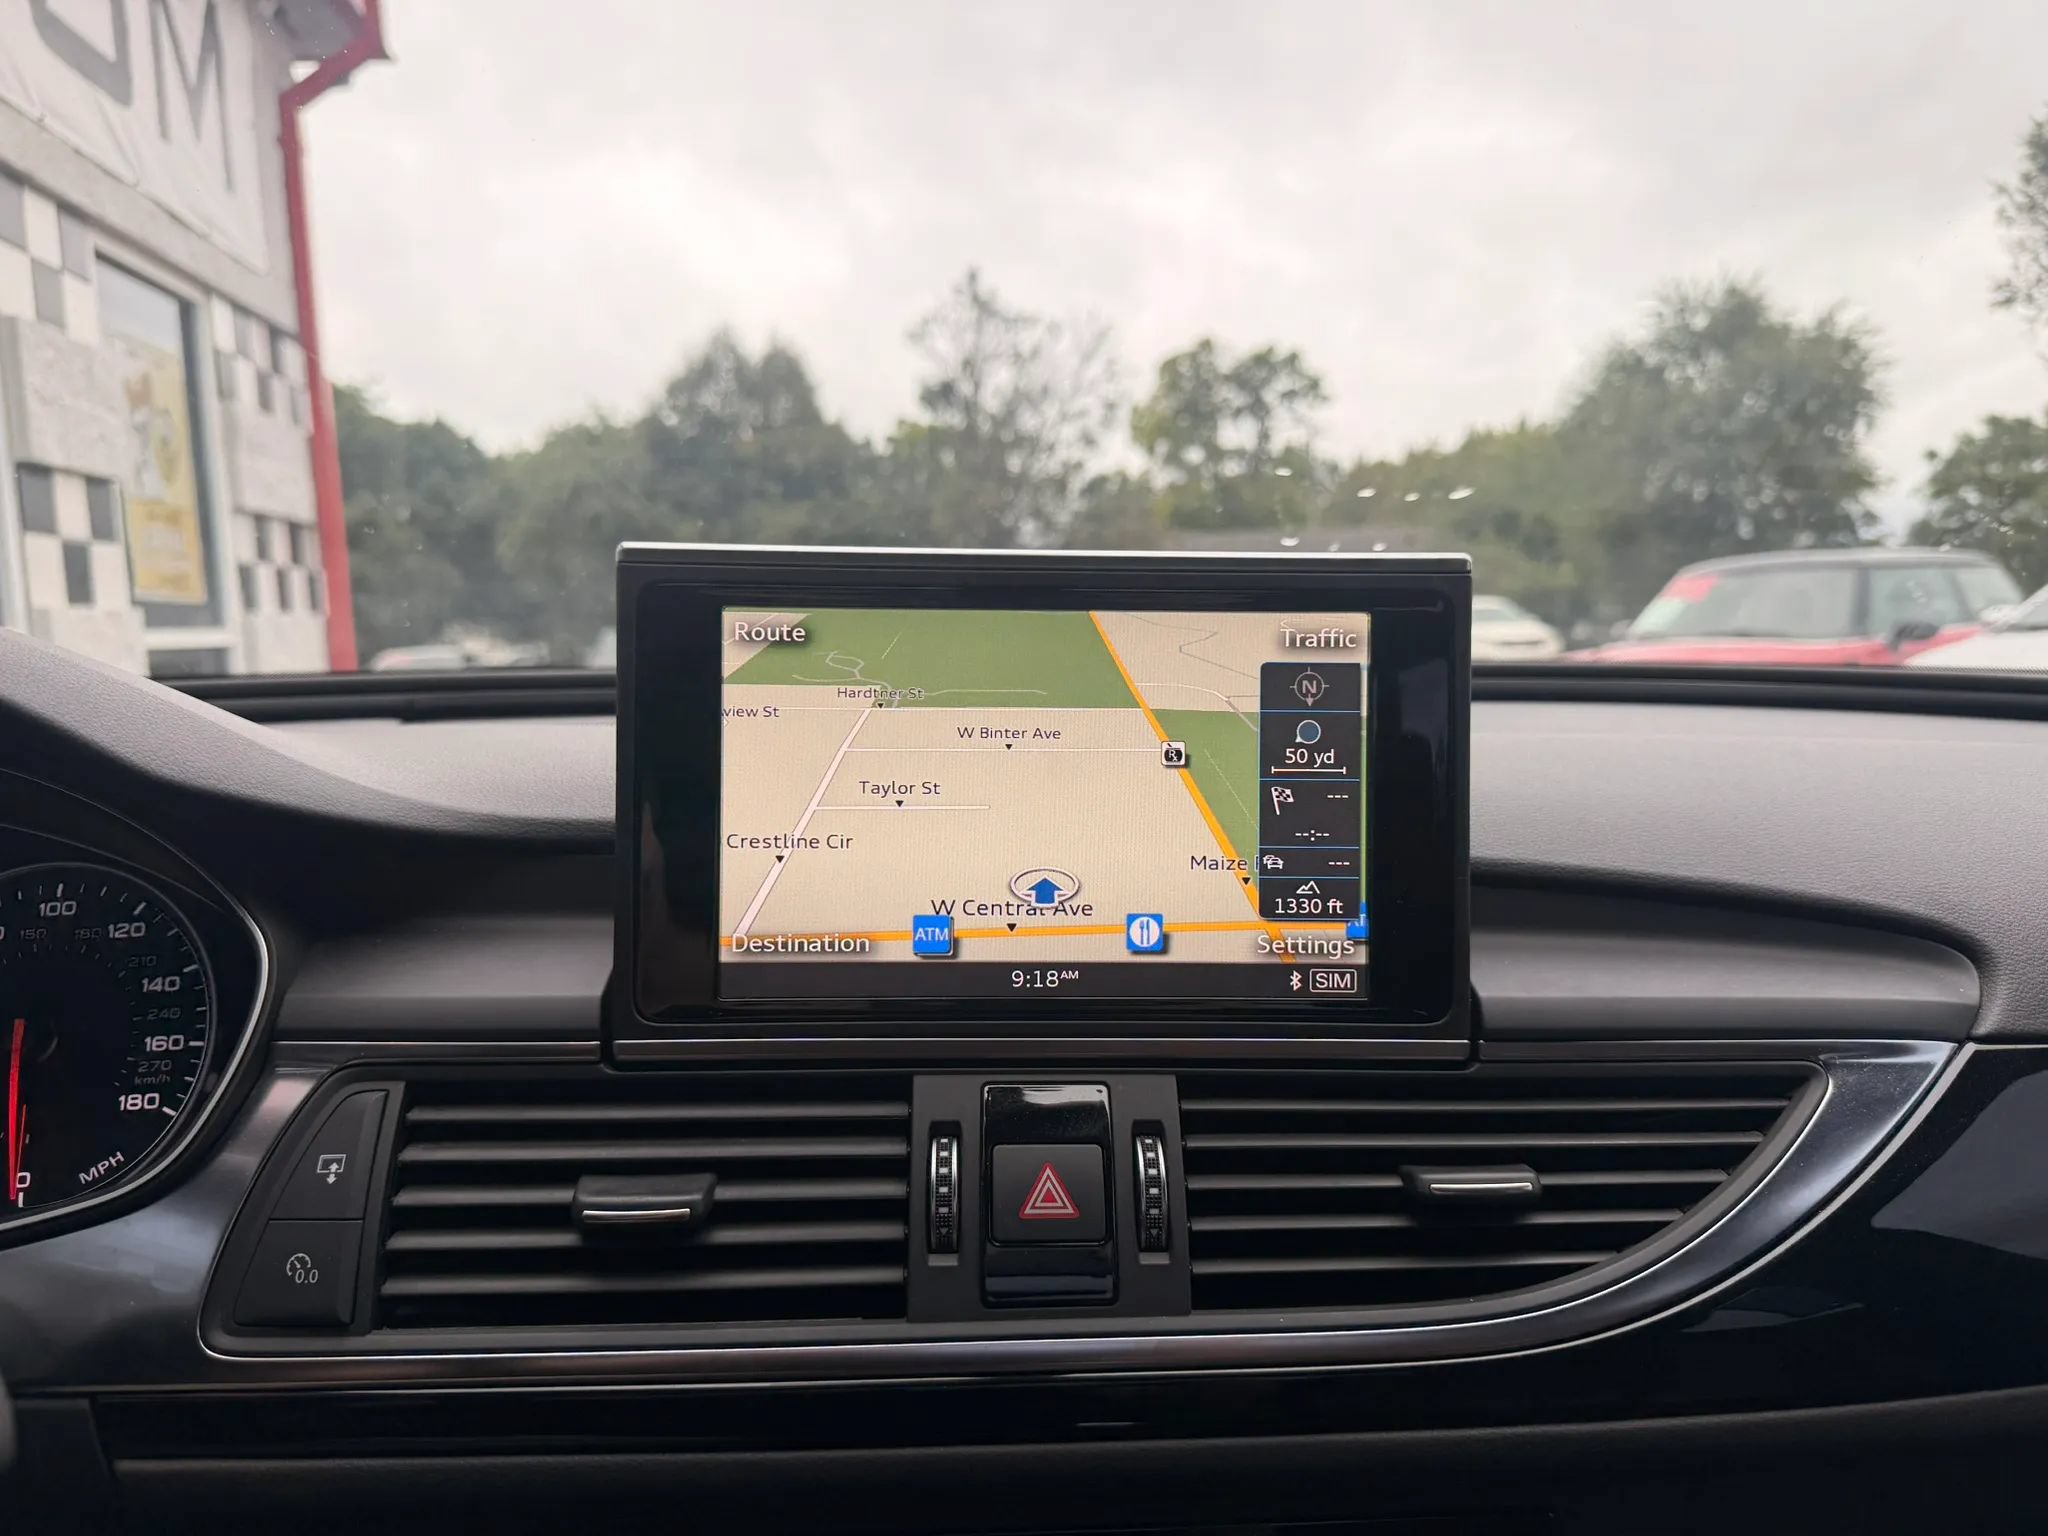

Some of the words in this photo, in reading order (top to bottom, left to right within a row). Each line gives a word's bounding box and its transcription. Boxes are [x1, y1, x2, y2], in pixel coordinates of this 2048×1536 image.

[733, 621, 807, 643] Route
[1281, 628, 1358, 649] Traffic
[837, 687, 902, 699] Hardtner
[908, 687, 924, 699] St
[721, 705, 759, 718] view
[762, 706, 780, 718] St
[957, 727, 975, 739] W
[980, 727, 1027, 739] Binter
[1032, 728, 1062, 740] Ave
[1285, 749, 1308, 763] 50
[1313, 748, 1335, 767] yd
[859, 781, 916, 799] Taylor
[922, 781, 941, 795] St
[726, 833, 820, 849] Crestline
[826, 834, 854, 849] Cir
[1190, 856, 1248, 871] Maize
[39, 900, 77, 917] 100
[931, 900, 956, 915] W
[1053, 903, 1093, 916] Ave
[1275, 898, 1322, 914] 1330
[1327, 898, 1343, 914] ft
[108, 922, 146, 939] 120
[914, 927, 949, 941] ATM
[731, 934, 870, 952] Destination
[1257, 935, 1355, 959] Settings
[128, 955, 157, 968] 210
[141, 975, 181, 993] 140
[1011, 970, 1060, 988] 9:18
[1060, 970, 1079, 980] AM
[1315, 973, 1351, 989] SIM
[146, 1008, 181, 1020] 240
[144, 1034, 184, 1052] 160
[137, 1059, 172, 1072] 270
[134, 1074, 171, 1085] km/h
[118, 1092, 160, 1111] 180
[78, 1151, 125, 1185] MPH
[295, 1269, 319, 1284] 0.0
